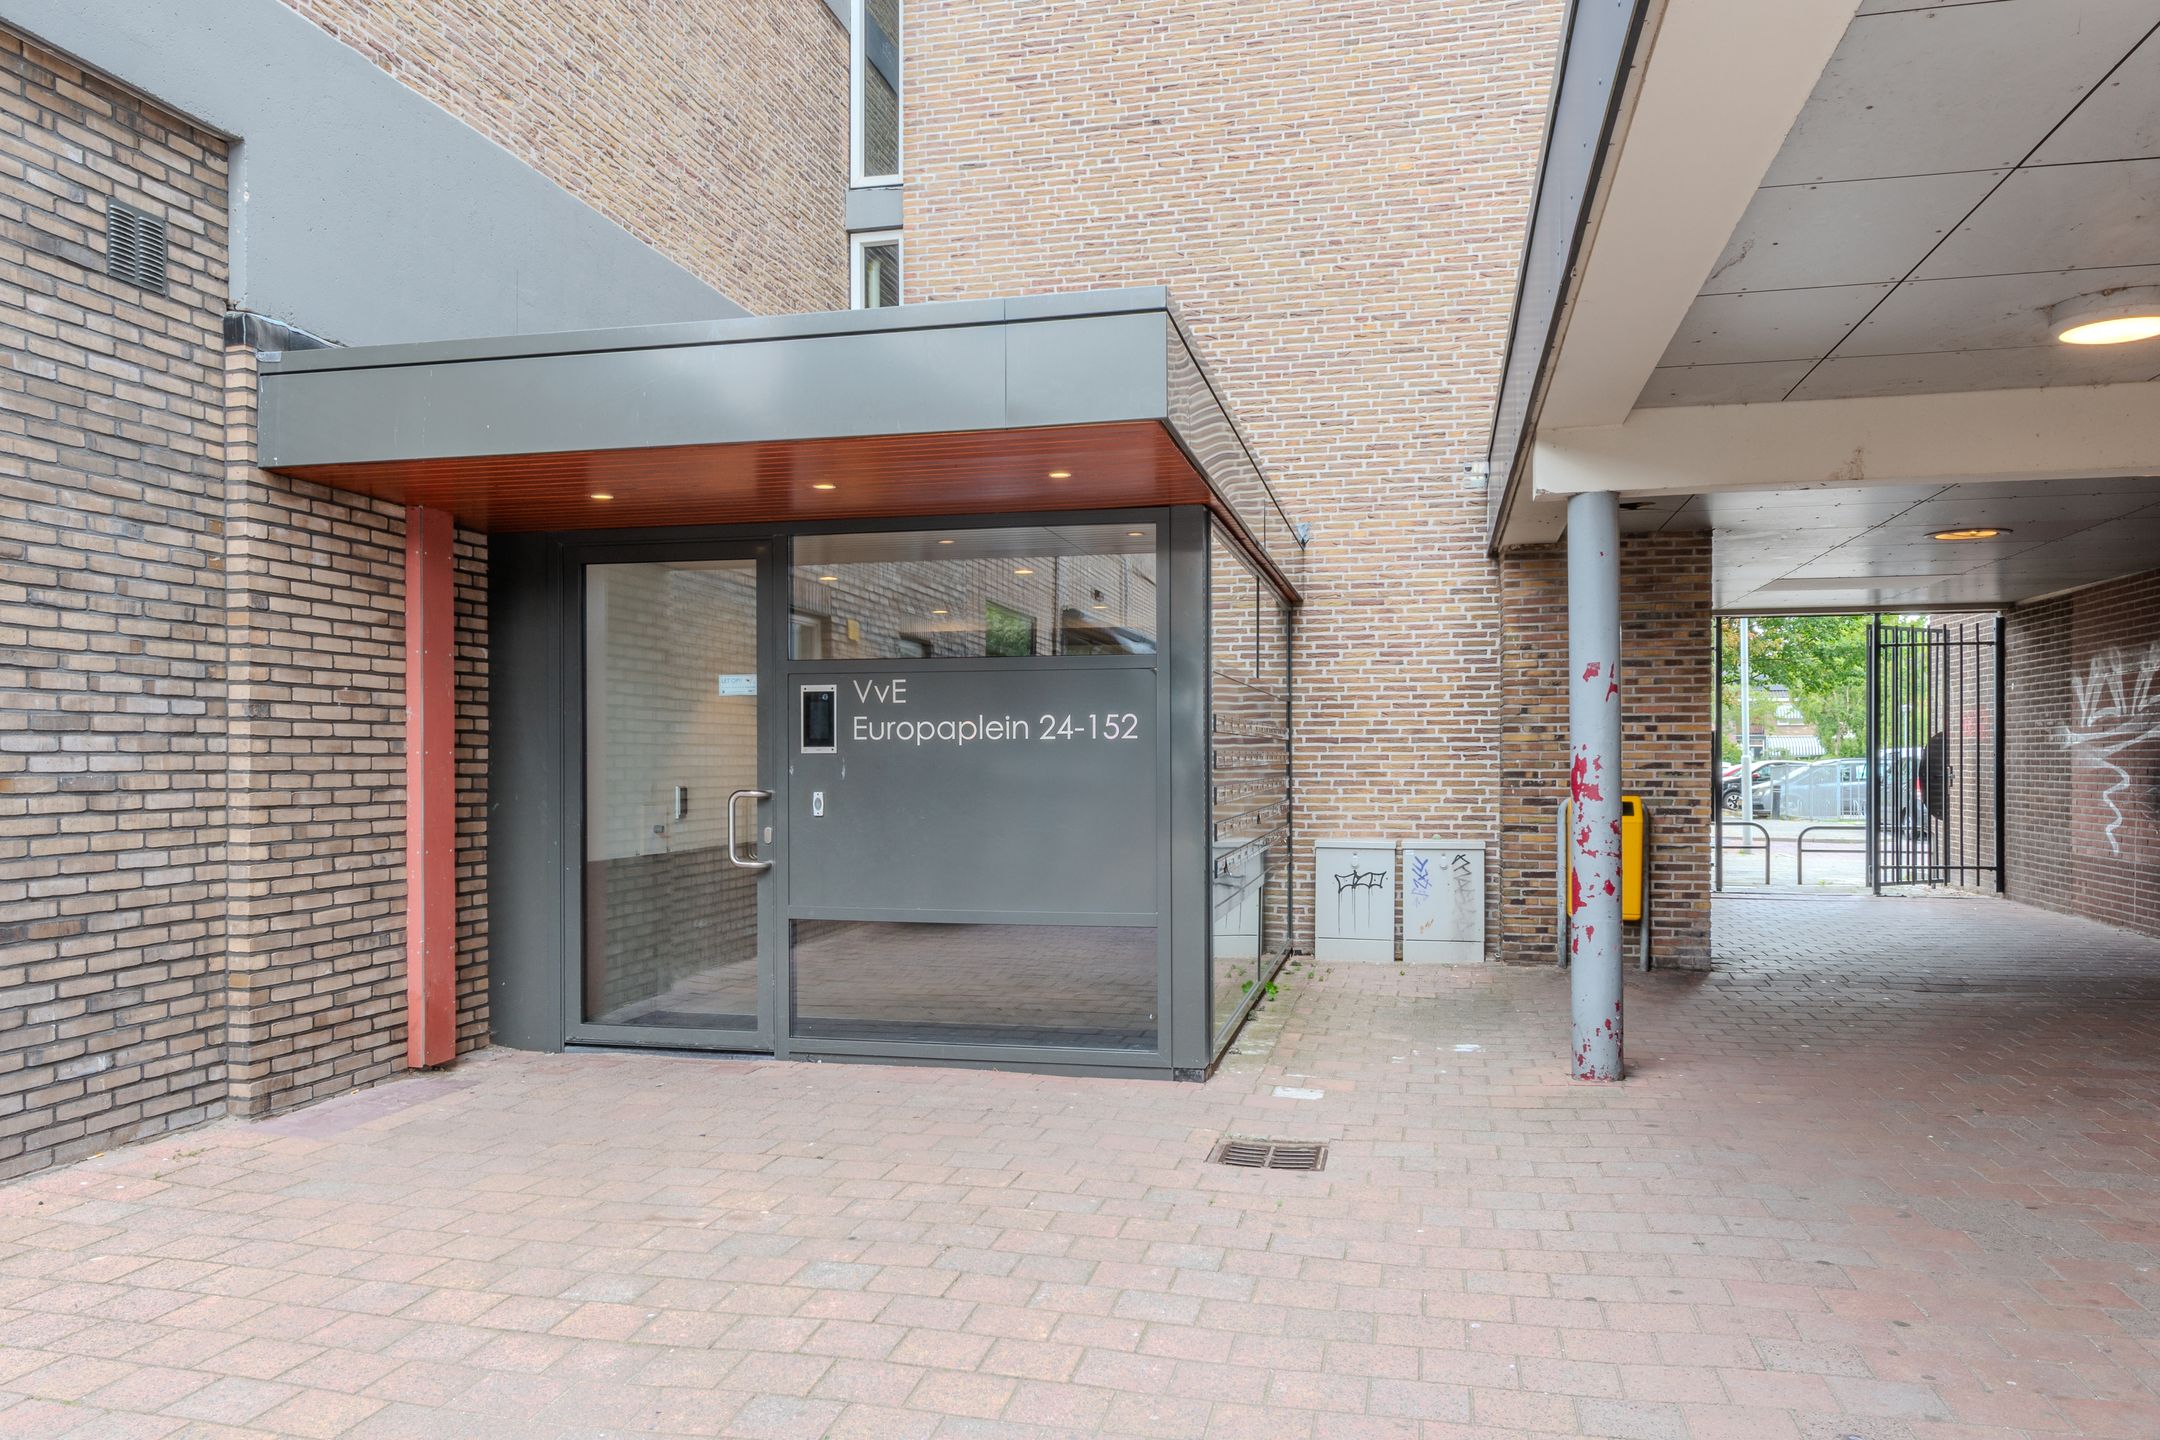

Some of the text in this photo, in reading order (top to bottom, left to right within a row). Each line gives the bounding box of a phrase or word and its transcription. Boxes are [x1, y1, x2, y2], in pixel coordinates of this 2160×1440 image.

[853, 679, 907, 704] VvE
[853, 712, 1139, 746] Europaplein 24-152
